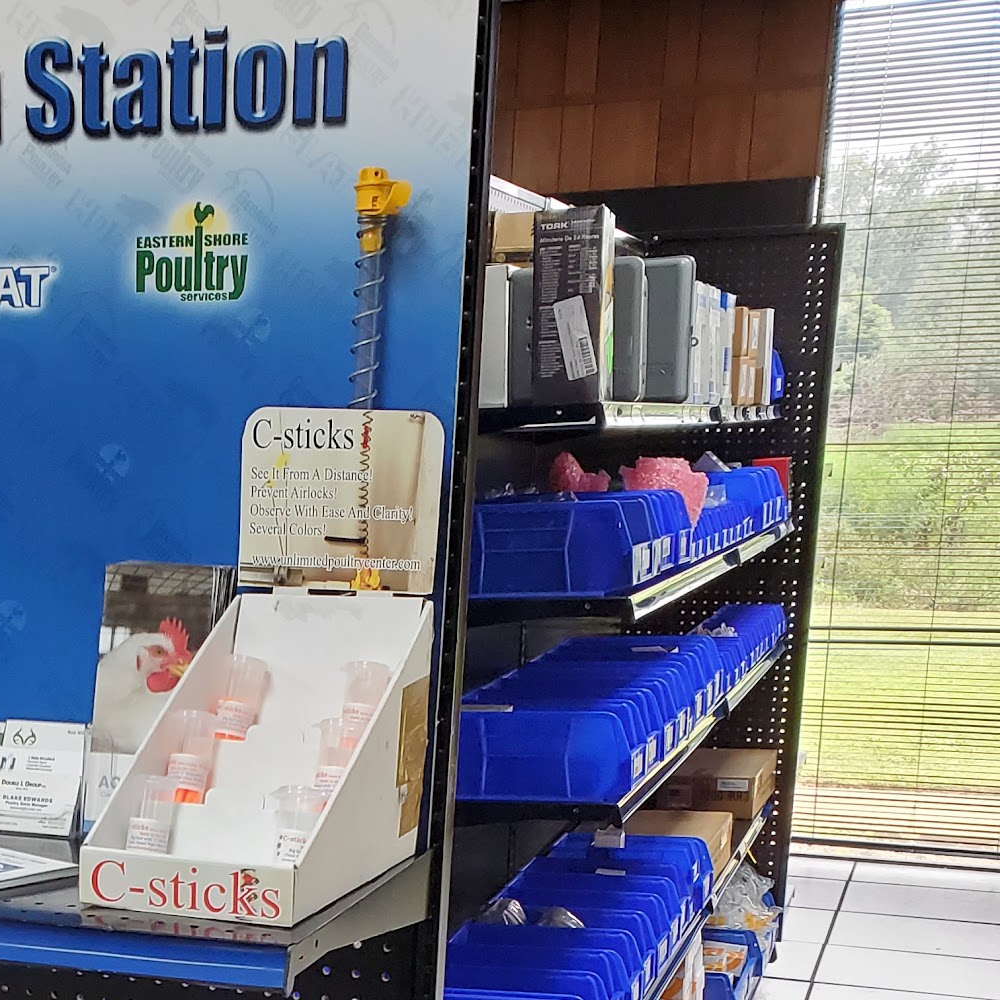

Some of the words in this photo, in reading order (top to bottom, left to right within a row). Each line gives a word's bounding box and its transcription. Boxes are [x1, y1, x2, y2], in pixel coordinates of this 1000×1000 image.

[25, 26, 349, 142] Station
[540, 221, 568, 230] TORK
[136, 235, 194, 248] EASTERN
[204, 233, 249, 246] SHORE
[136, 226, 248, 300] Poultry
[180, 292, 228, 302] services
[253, 418, 354, 450] C-sticks
[251, 467, 269, 480] See
[272, 467, 281, 480] It
[283, 467, 309, 481] From
[312, 467, 321, 481] A
[324, 468, 372, 482] Distance!
[251, 486, 288, 499] Prevent
[291, 487, 337, 500] Airlocks!
[250, 504, 291, 518] Observe
[294, 505, 318, 518] With
[322, 506, 345, 518] Ease
[348, 505, 370, 519] And
[373, 506, 413, 523] Clarity!
[250, 522, 286, 536] Several
[289, 523, 326, 536] Colors!
[252, 553, 420, 571] www.unlimitedpoultrycenter.com
[91, 859, 281, 919] C-sticks
